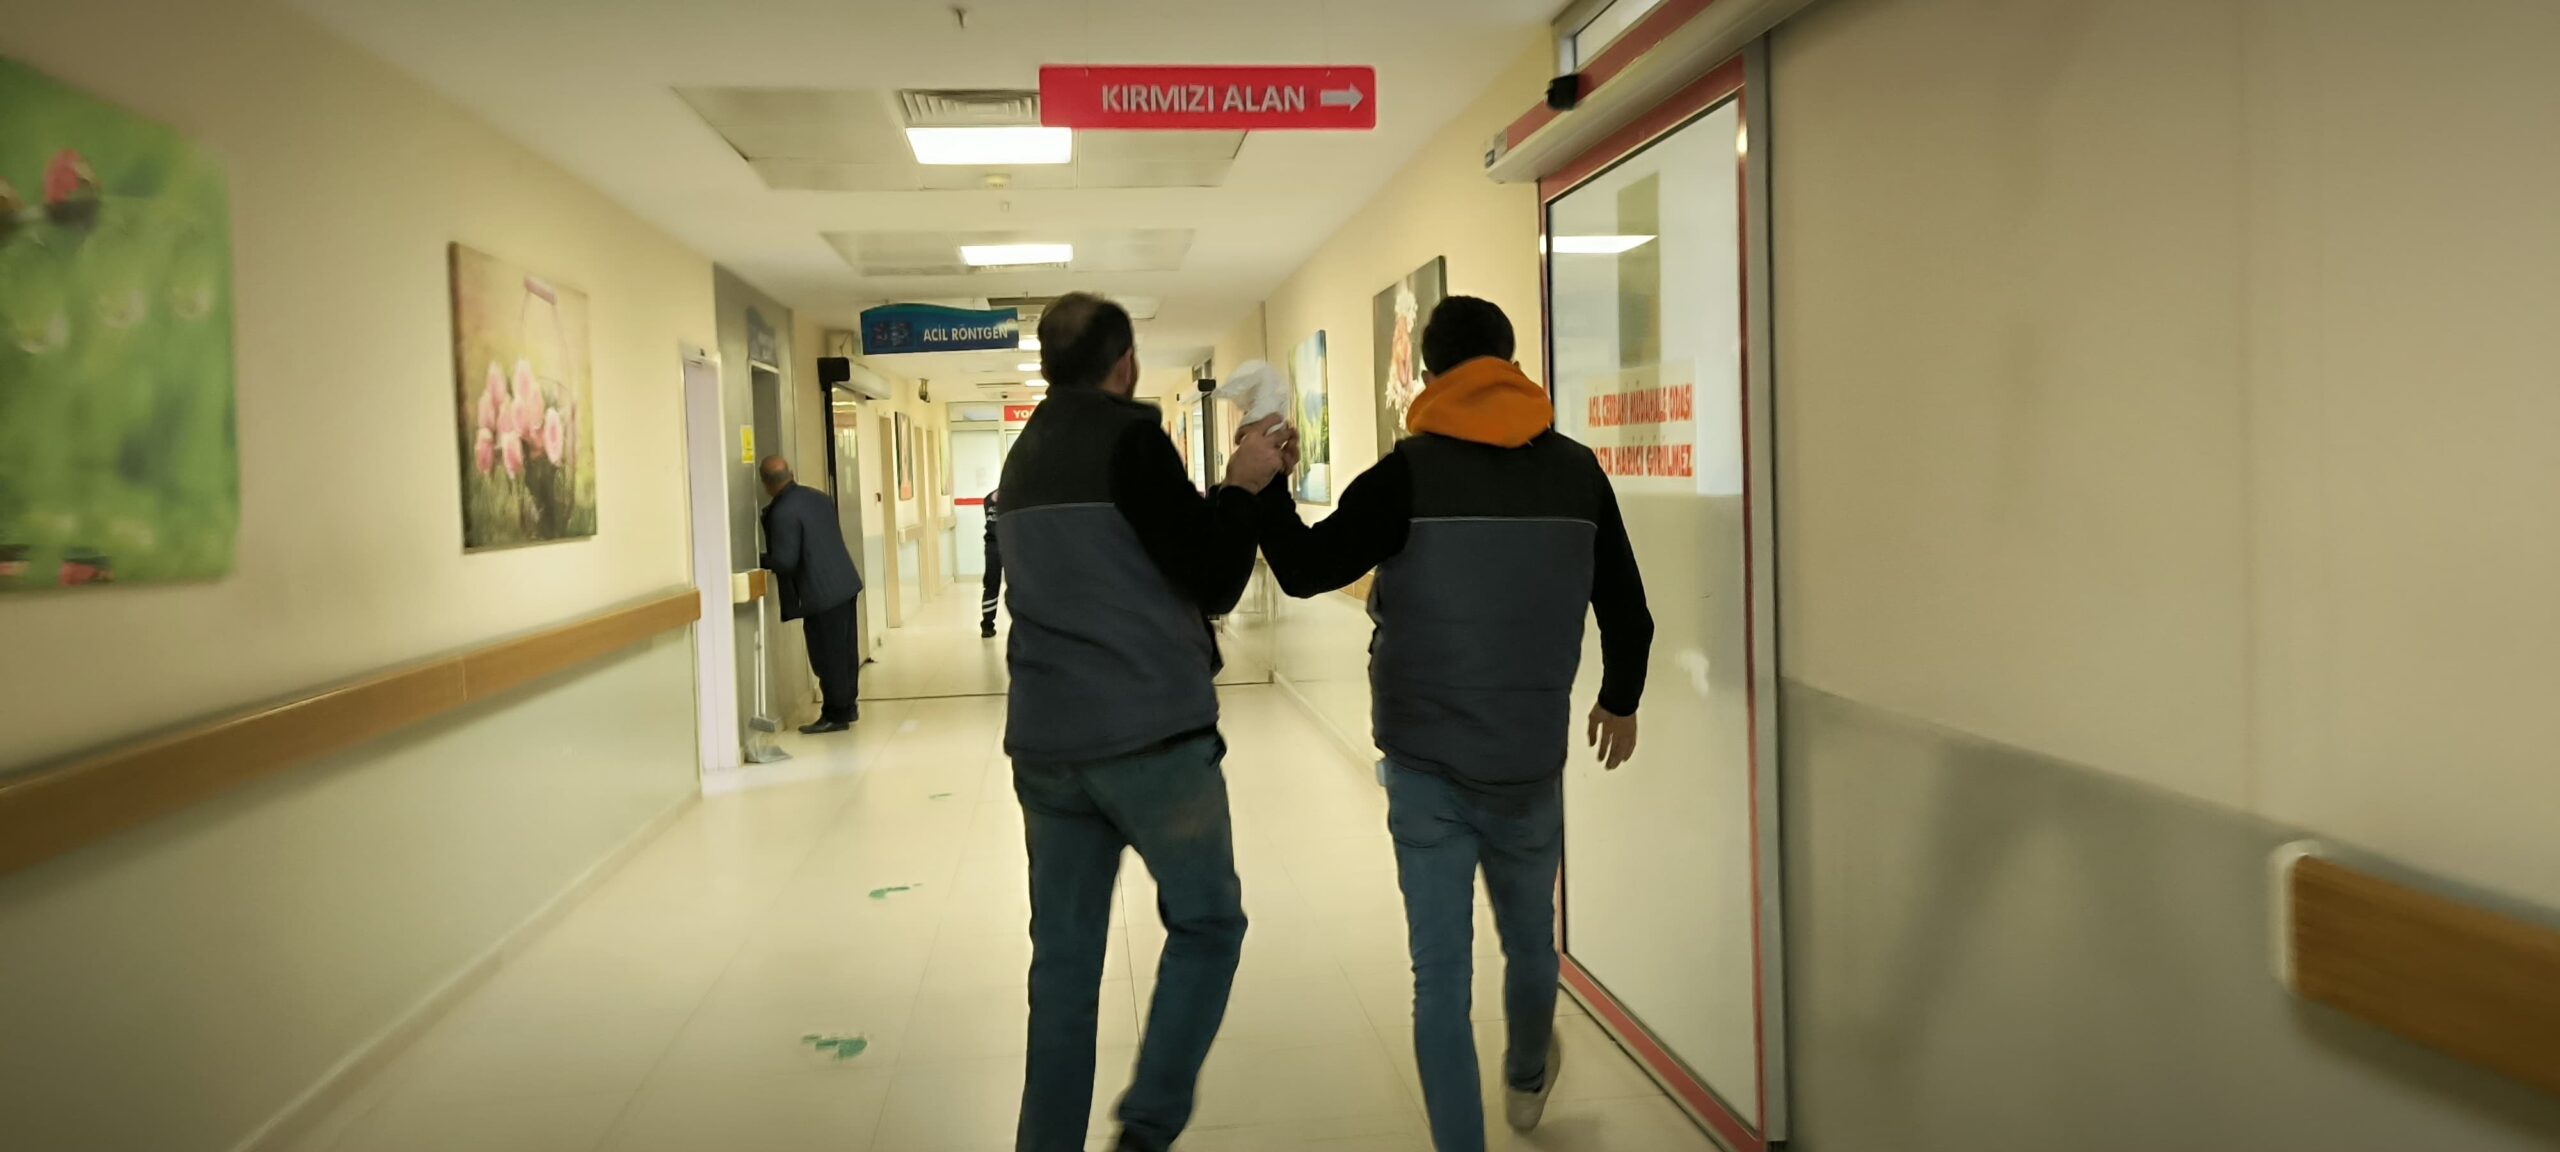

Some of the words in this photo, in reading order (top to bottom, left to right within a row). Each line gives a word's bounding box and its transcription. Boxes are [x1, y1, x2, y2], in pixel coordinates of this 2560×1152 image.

[1102, 85, 1214, 112] KIRMIZI
[1222, 85, 1305, 112] ALAN
[923, 324, 948, 342] ACİL
[951, 324, 1008, 341] RÖNTGEN
